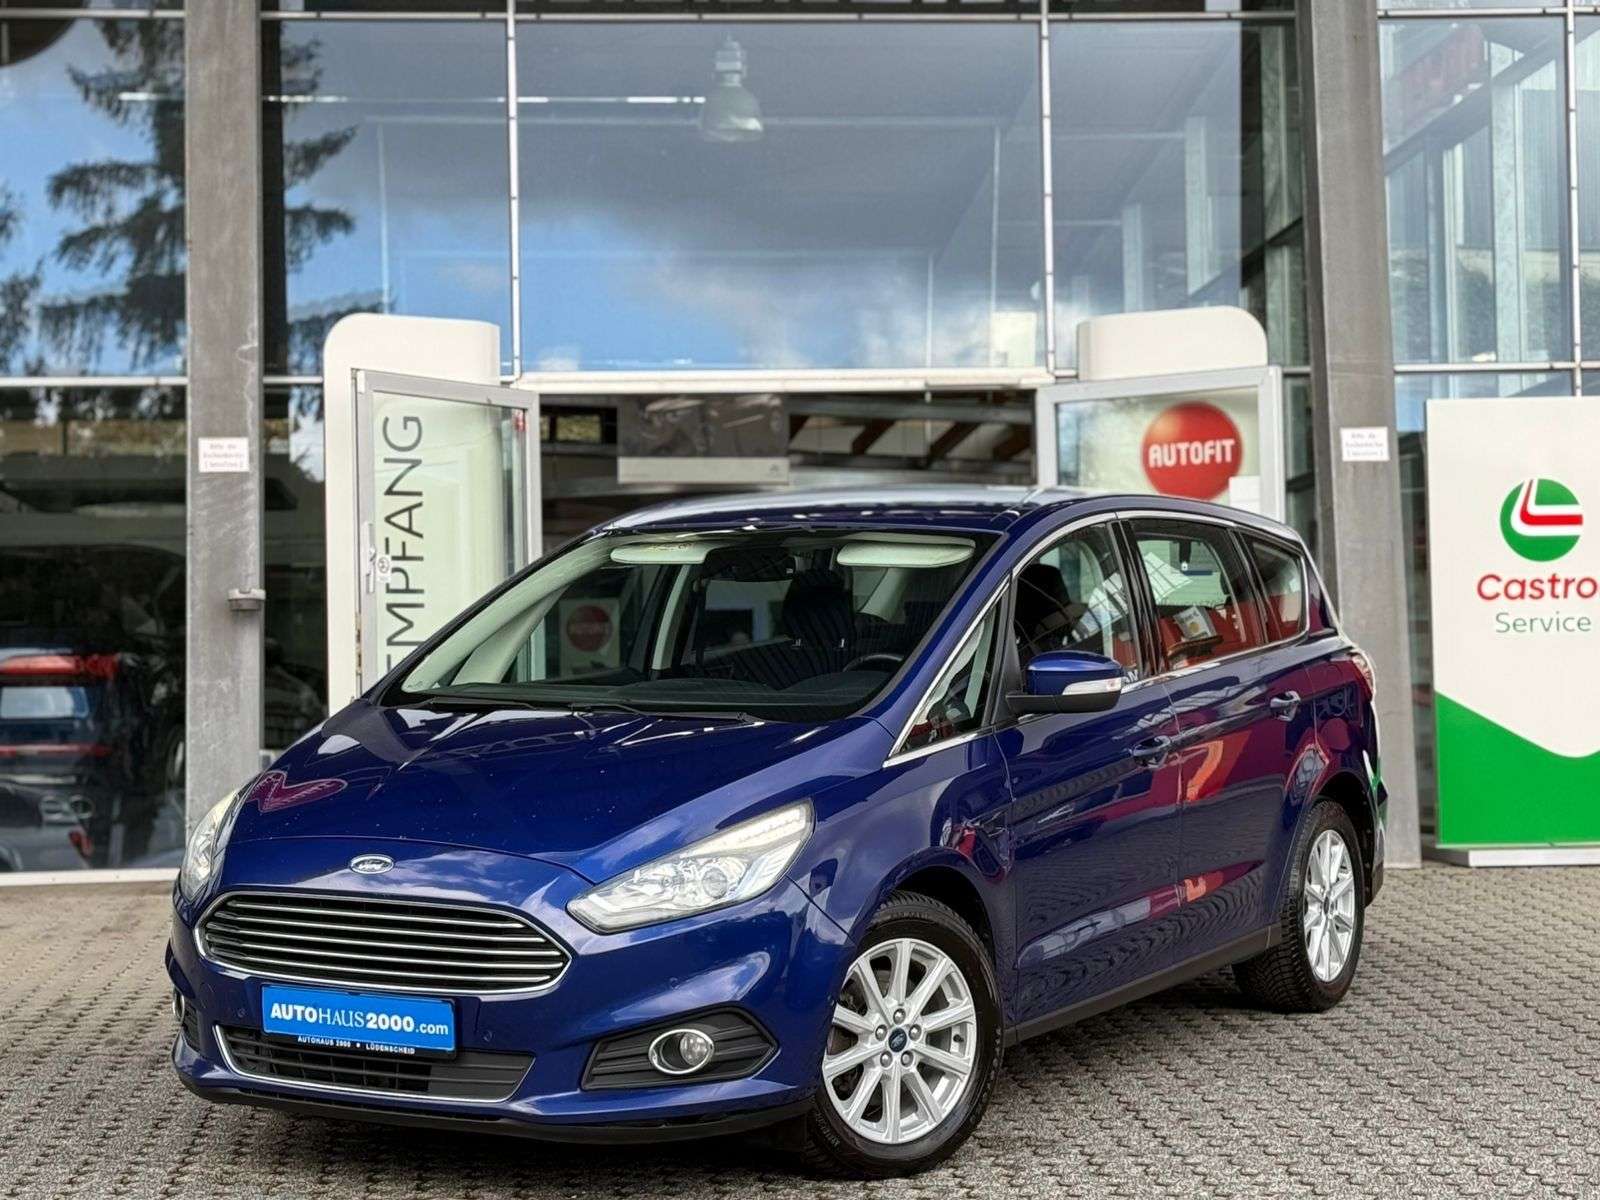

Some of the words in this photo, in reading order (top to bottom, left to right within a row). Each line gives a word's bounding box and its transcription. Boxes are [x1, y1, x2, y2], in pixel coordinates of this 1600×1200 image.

[1148, 437, 1236, 468] AUTOFIT
[1476, 572, 1598, 601] Castro
[1495, 610, 1592, 634] Service
[297, 1035, 334, 1047] AUTOHAUS
